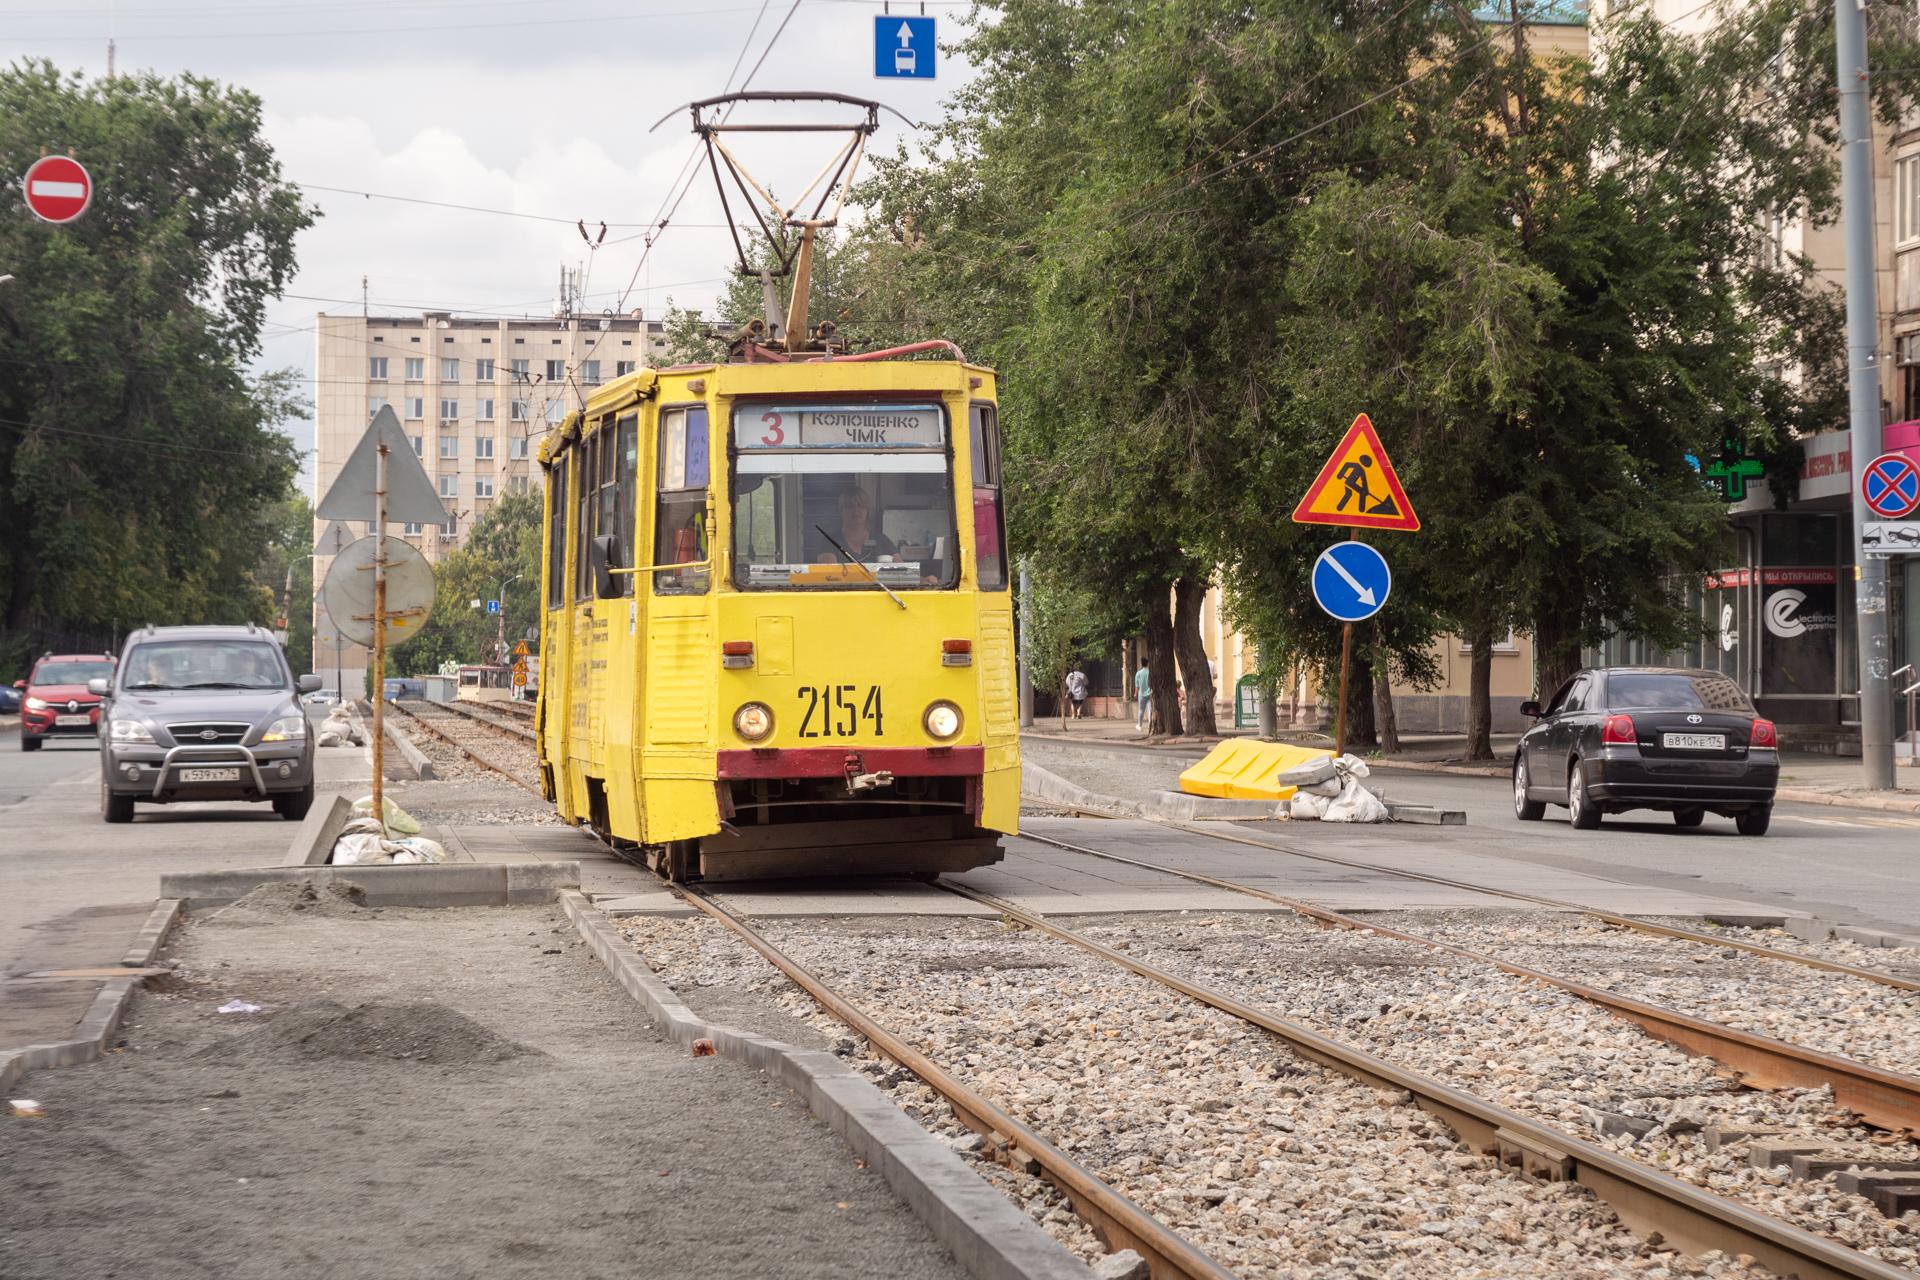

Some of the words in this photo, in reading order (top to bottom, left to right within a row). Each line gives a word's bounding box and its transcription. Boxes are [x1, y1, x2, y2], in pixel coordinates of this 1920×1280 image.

[761, 412, 785, 447] 3
[812, 412, 920, 430] КОЛЮЩЕНКО
[846, 428, 887, 443] ЧМК
[797, 684, 884, 738] 2154
